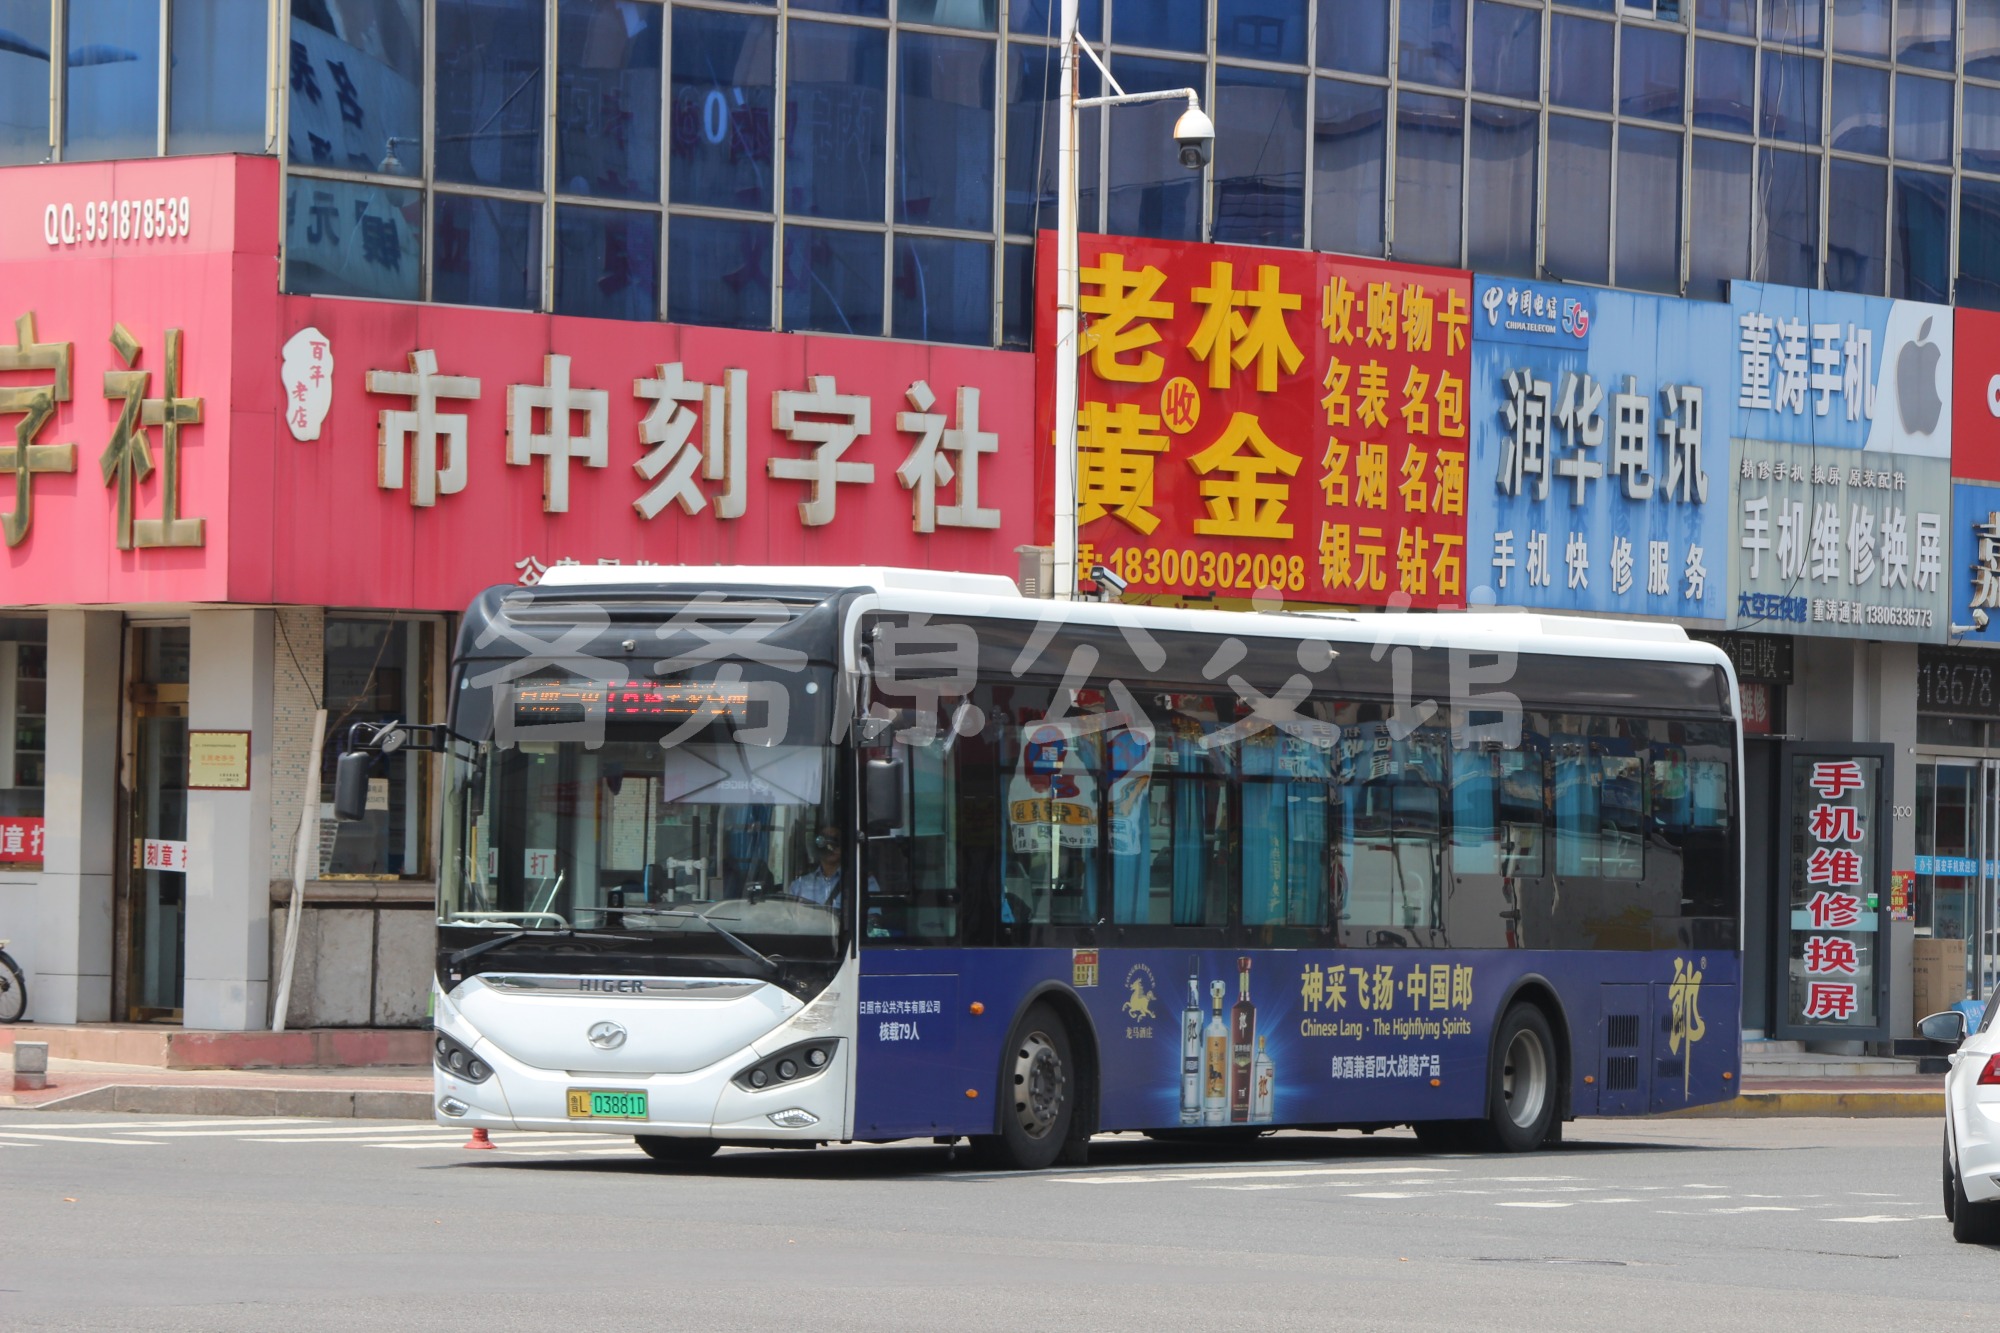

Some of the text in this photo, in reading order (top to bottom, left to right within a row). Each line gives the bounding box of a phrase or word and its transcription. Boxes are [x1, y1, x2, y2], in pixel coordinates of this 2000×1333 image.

[45, 197, 190, 245] QQ:931878539
[1077, 252, 1305, 393] 老林
[1321, 276, 1468, 357] 收:购物卡
[1507, 287, 1589, 338] 中国电信 5G
[309, 341, 327, 388] 百年
[1739, 312, 1876, 422] 董涛手机
[291, 381, 308, 428] 老店
[1166, 381, 1196, 427] 收
[366, 349, 1000, 533] 市中刻字社
[1497, 368, 1708, 505] 润华电讯
[1053, 402, 1303, 540] 黄金
[1741, 460, 1907, 490] 精修手机 换屏 原装配件
[1493, 530, 1707, 600] 手机快修服务
[1742, 496, 1942, 592] 手机维修换屏
[1738, 592, 1933, 628] 太空石快修 董涛通讯 13806336773
[1803, 762, 1865, 1020] 手机维修换屏
[580, 979, 643, 993] HIGER
[860, 1000, 941, 1015] 日照市公共汽车有限公司
[1300, 963, 1473, 1012] 神采飞扬·中国郎
[879, 1021, 920, 1041] 核载79人
[1126, 1026, 1153, 1039] 龙马酒庄
[1301, 1017, 1472, 1041] Chinese Lang The Highflying Spirits
[1332, 1054, 1441, 1080] 郎酒兼香四大战略产品
